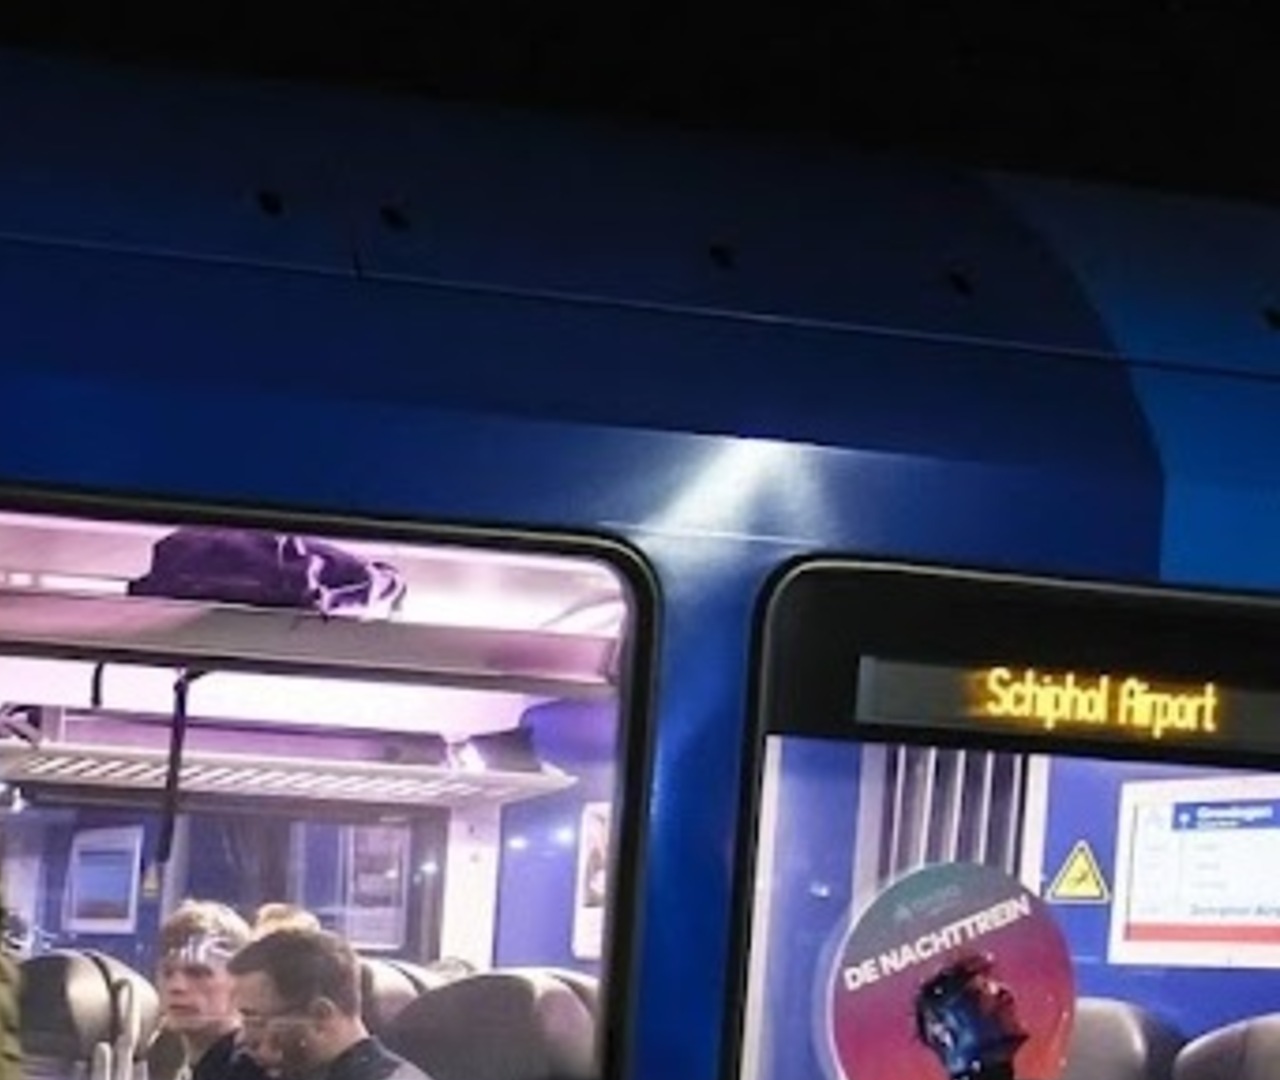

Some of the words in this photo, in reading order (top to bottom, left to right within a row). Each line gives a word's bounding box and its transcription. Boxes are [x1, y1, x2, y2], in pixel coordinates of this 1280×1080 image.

[986, 666, 1109, 730] Schiphol
[1117, 677, 1218, 739] Airport
[843, 958, 880, 991] DE
